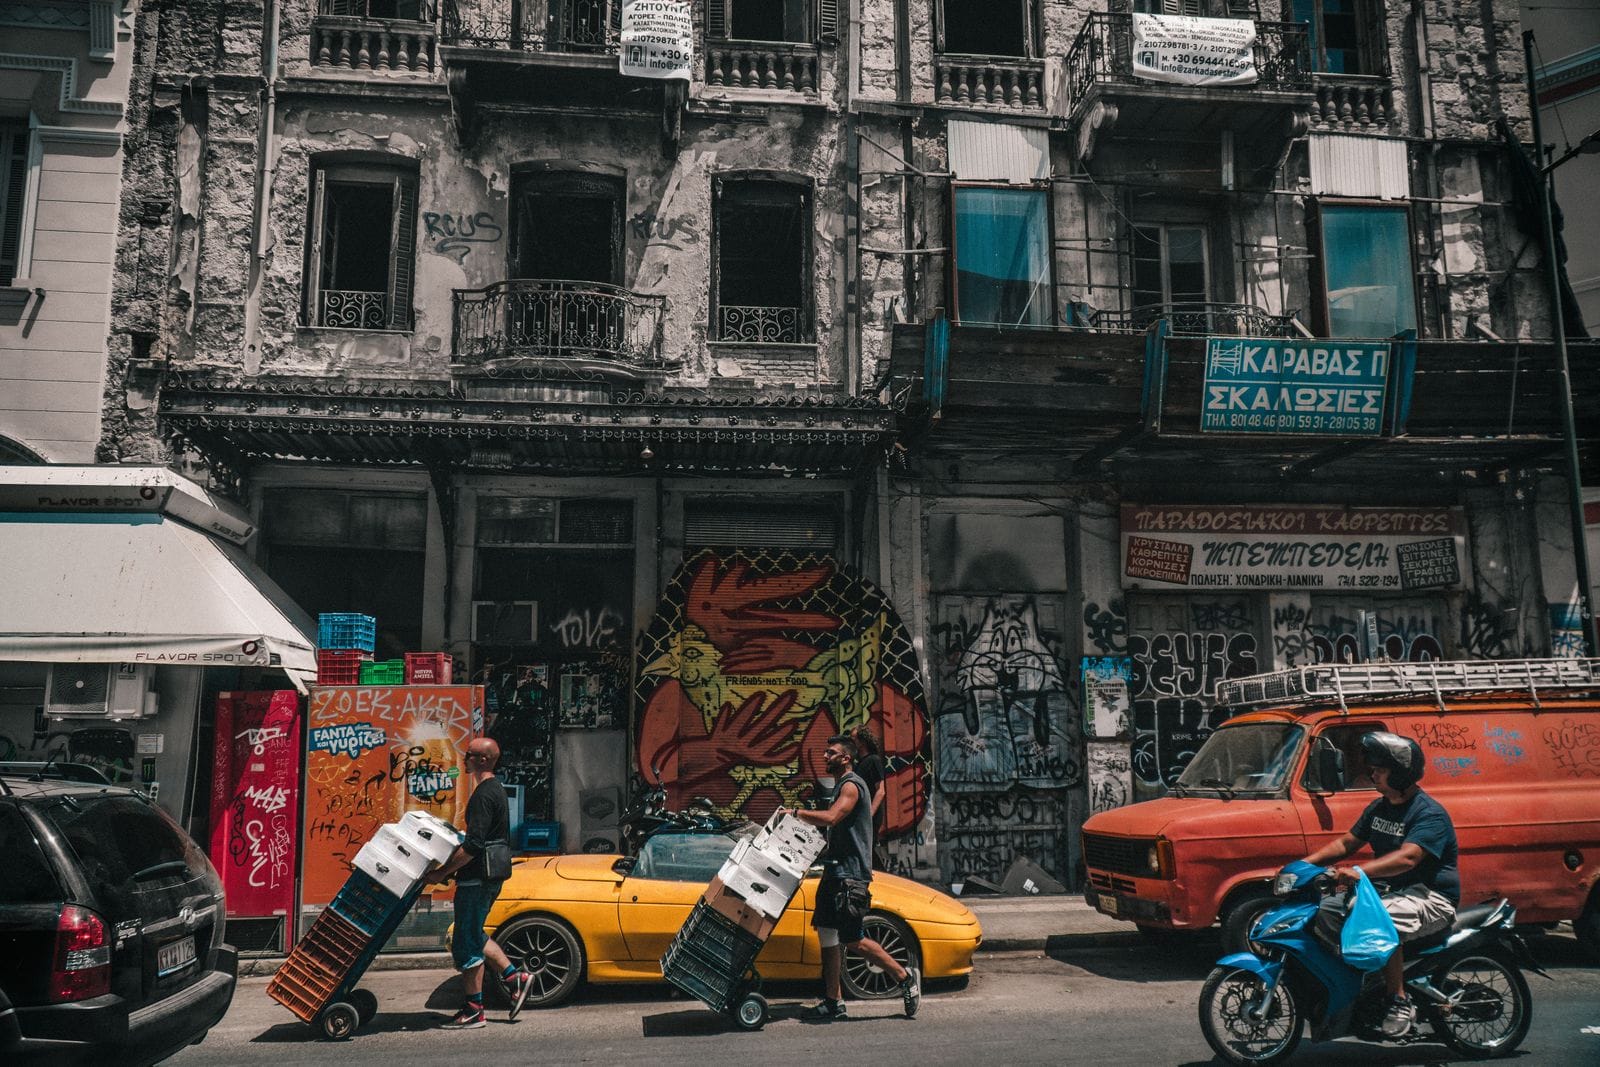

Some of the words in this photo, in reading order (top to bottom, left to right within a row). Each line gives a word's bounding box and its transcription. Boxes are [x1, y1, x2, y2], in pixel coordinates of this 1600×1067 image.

[661, 49, 681, 60] +30
[1172, 54, 1190, 63] +30
[1242, 346, 1364, 376] ΚΑΡΑΒΑΣ
[1207, 386, 1382, 414] ΣΚΑΛΩΣΙΕΣ
[37, 496, 100, 507] FLAVOR
[103, 497, 142, 507] SPOT
[1316, 511, 1449, 532] ΚΑΘΡΕΠΤΕΣ
[1133, 538, 1189, 553] ΚΡΥΣΤΑΛΛΑ
[1399, 539, 1452, 553] ΚΟΝΣΟΛΕΣ
[1130, 547, 1189, 563] ΚΑΘΡΕΠΤΕΣ
[1402, 548, 1452, 562] ΒΙΤΡΙΝΕΣ
[1131, 557, 1186, 573] ΚΟΡΝΙΖΕΣ
[1402, 556, 1456, 570] ΣΕΚΡΕΤΕΡ
[1127, 566, 1187, 582] ΜΙΚΡΟΕΠΙΠΛΑ
[135, 652, 198, 662] FLAVOR
[202, 653, 244, 663] SPOT
[313, 726, 356, 742] FANTA
[407, 771, 453, 793] FANTA
